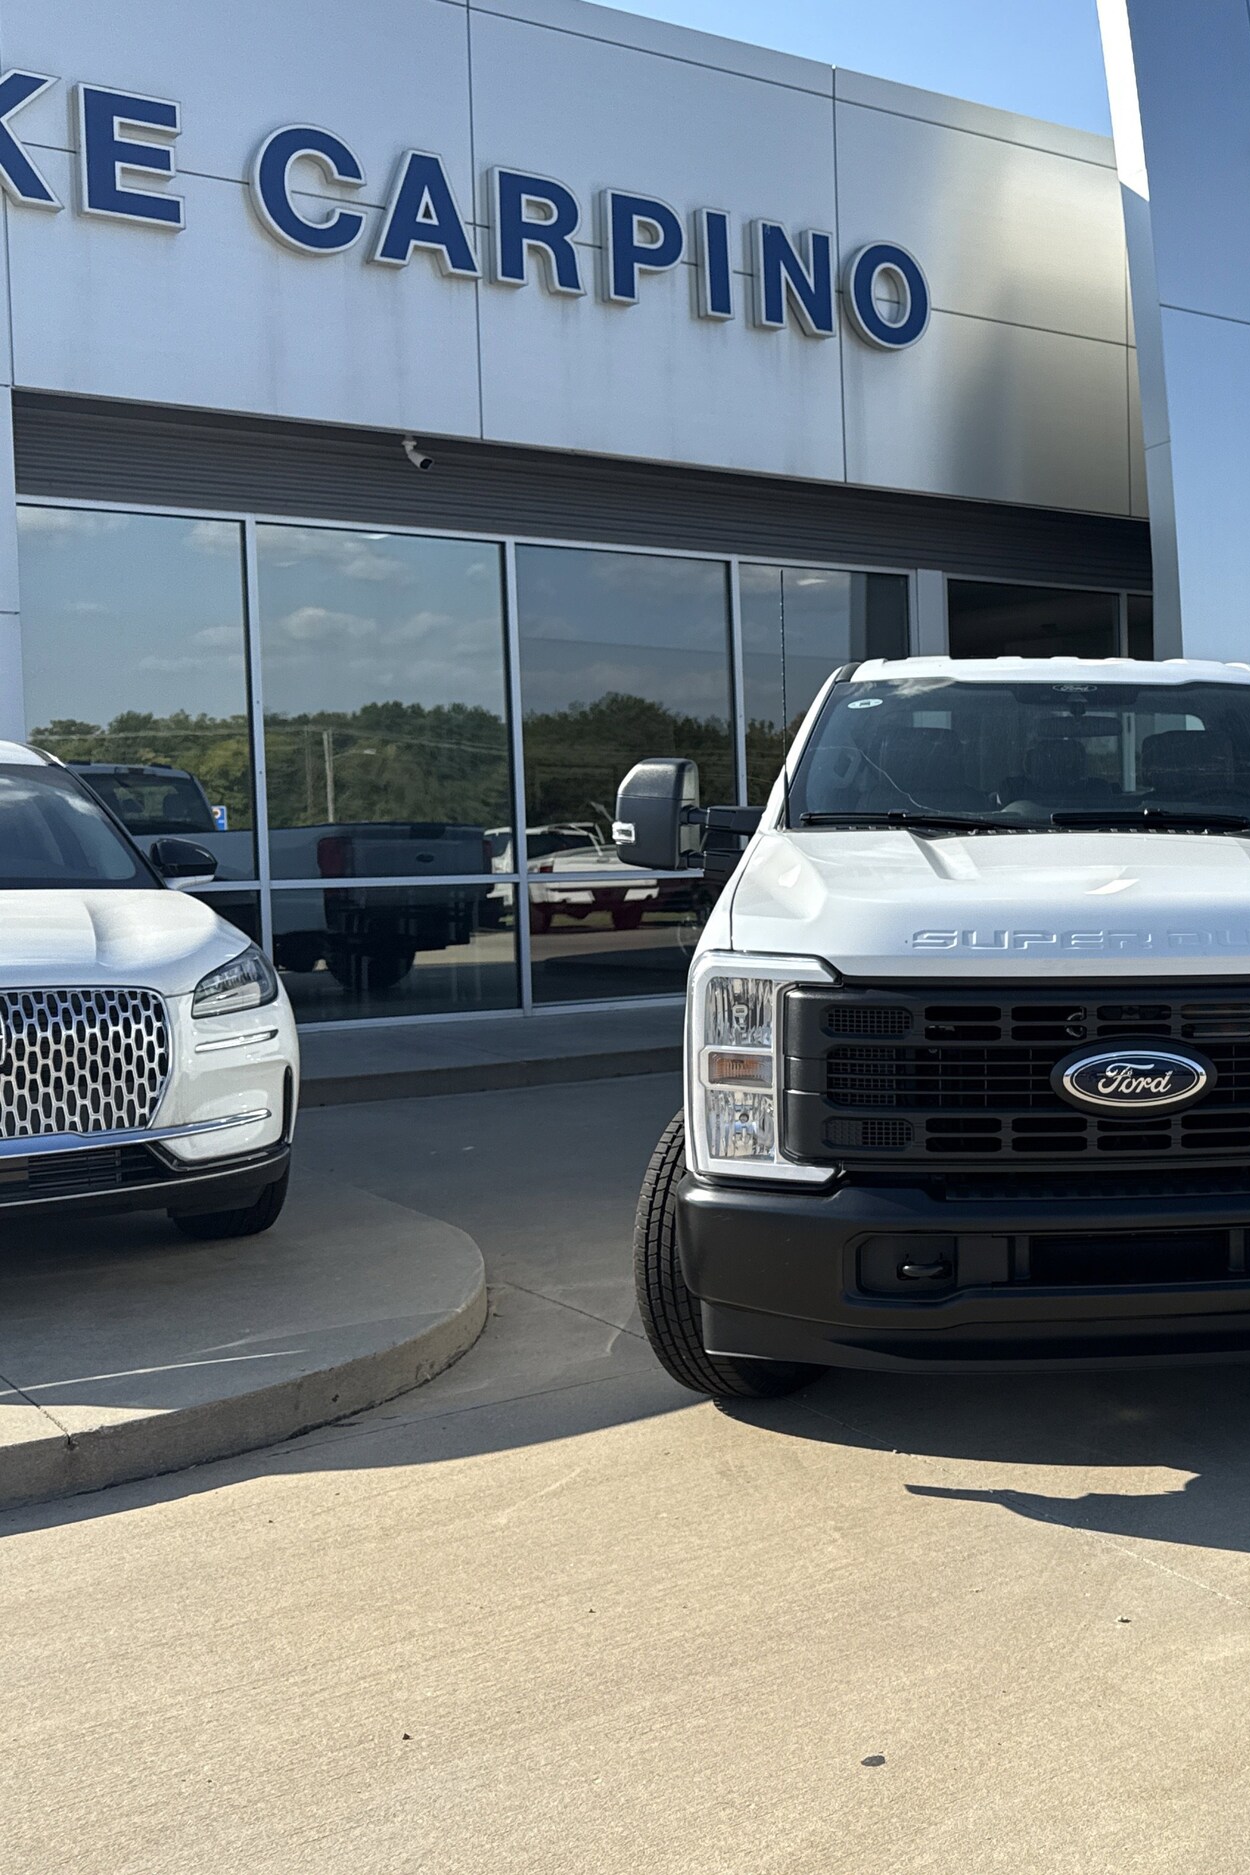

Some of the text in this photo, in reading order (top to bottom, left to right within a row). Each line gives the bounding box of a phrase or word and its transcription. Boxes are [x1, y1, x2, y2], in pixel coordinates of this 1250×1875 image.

[249, 123, 932, 352] CARPINO
[911, 929, 1152, 950] SUPER
[1097, 1062, 1173, 1094] Ford
